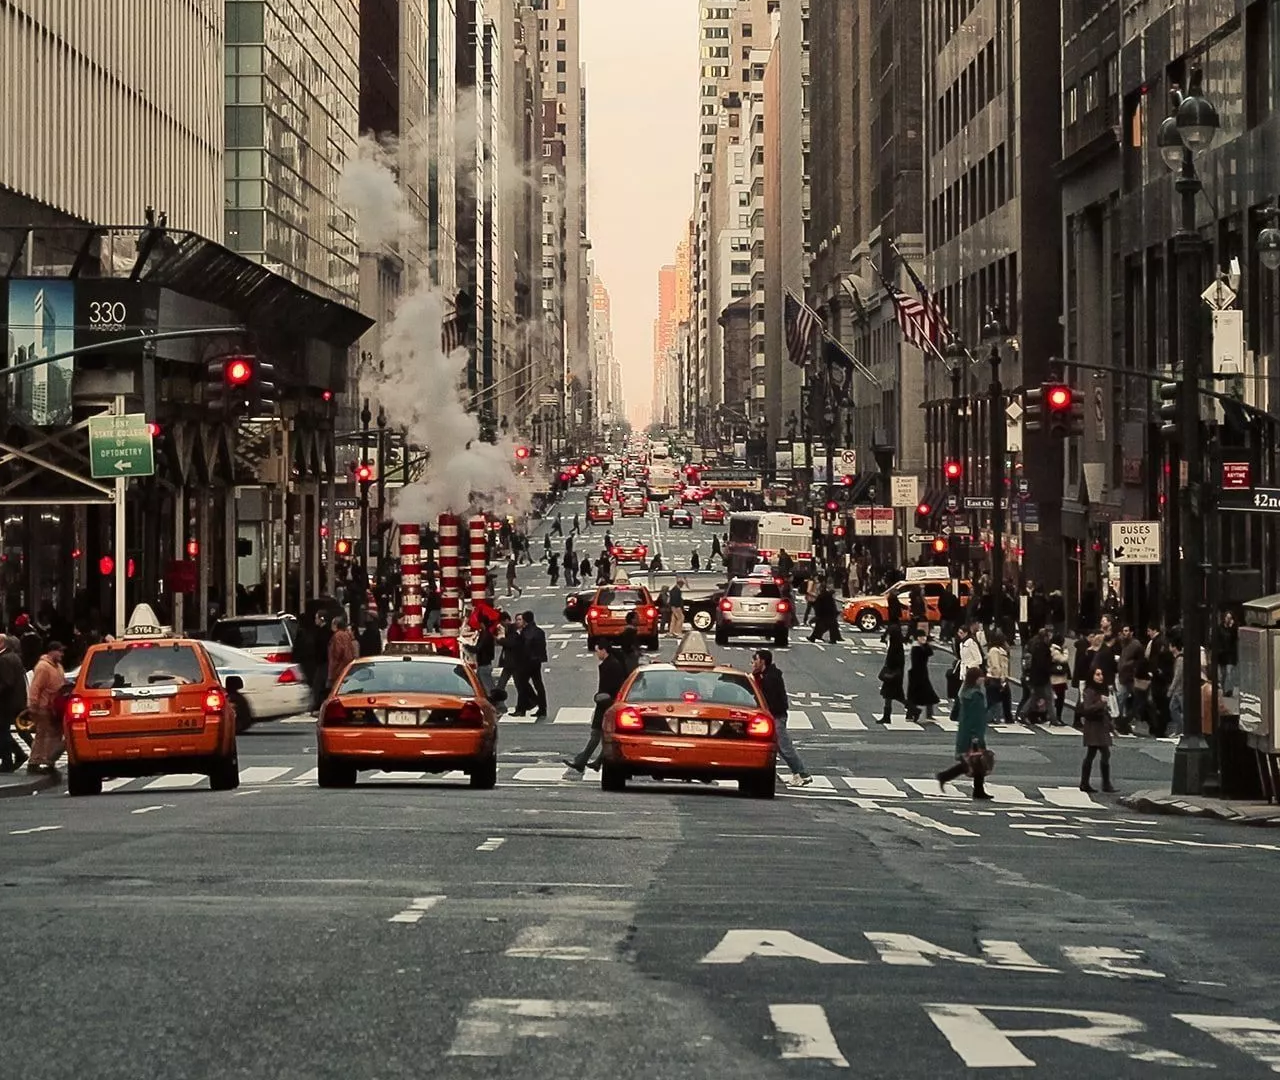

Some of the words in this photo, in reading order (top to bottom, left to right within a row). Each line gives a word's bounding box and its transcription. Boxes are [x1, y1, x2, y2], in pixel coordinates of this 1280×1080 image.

[89, 302, 127, 323] 330
[89, 323, 126, 332] MADISON
[100, 448, 143, 458] OPTOMETRY
[1120, 525, 1151, 534] BUSES
[1123, 536, 1147, 545] ONLY
